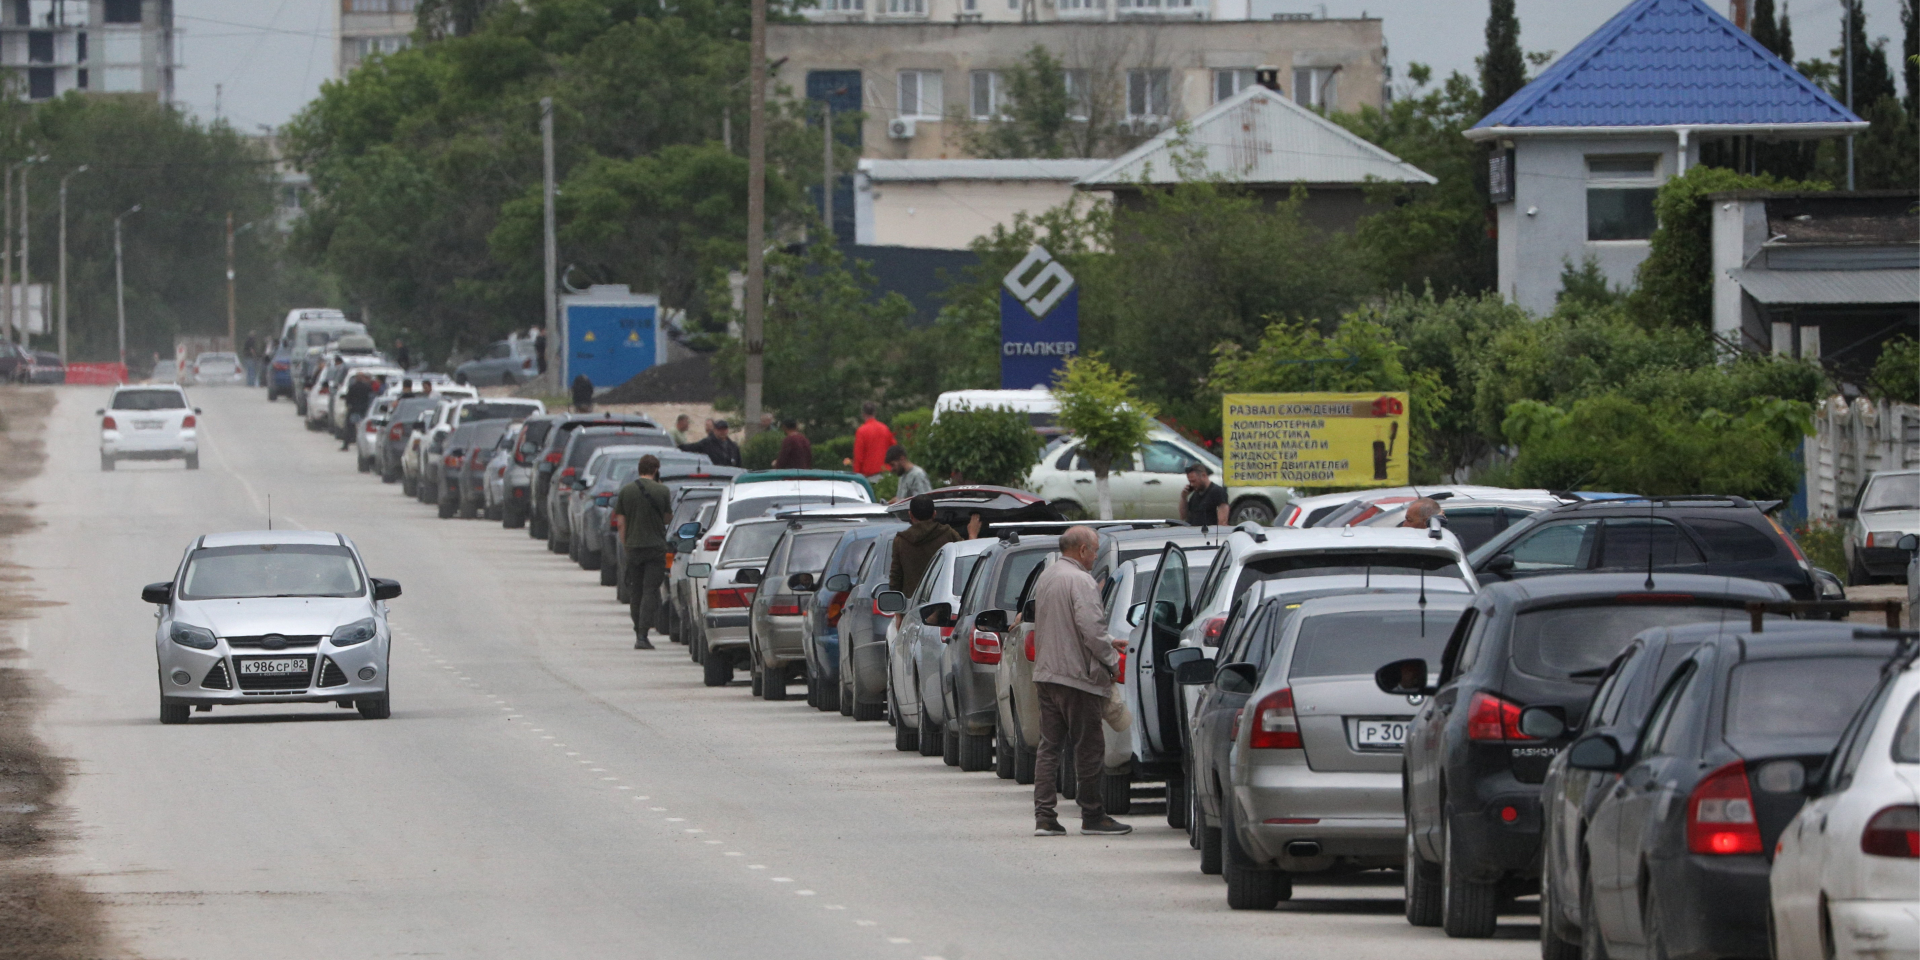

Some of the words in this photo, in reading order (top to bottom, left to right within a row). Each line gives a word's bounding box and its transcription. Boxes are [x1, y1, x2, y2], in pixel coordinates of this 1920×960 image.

[1003, 342, 1076, 356] СТАЛКЕР
[1229, 405, 1275, 415] РАЗВАЛ
[1278, 404, 1352, 415] СХОЖДЕНИЕ
[1230, 420, 1325, 429] -КОМПЬЮТЕРНАЯ
[1230, 430, 1310, 441] ДИАГНОСТИКА
[1230, 441, 1278, 450] -ЗАМЕНА
[1281, 441, 1318, 449] МАСЕЛ
[1320, 440, 1328, 449] И
[1230, 450, 1297, 461] ЖИДКОСТЕЙ
[1231, 461, 1278, 470] -РЕМОНТ
[1281, 460, 1349, 471] ДВИГАТЕЛЕЙ
[1230, 471, 1278, 480] -РЕМОНТ
[1281, 470, 1334, 481] ХОДОВОЙ
[293, 660, 304, 668] 82
[1367, 724, 1409, 741] Р30
